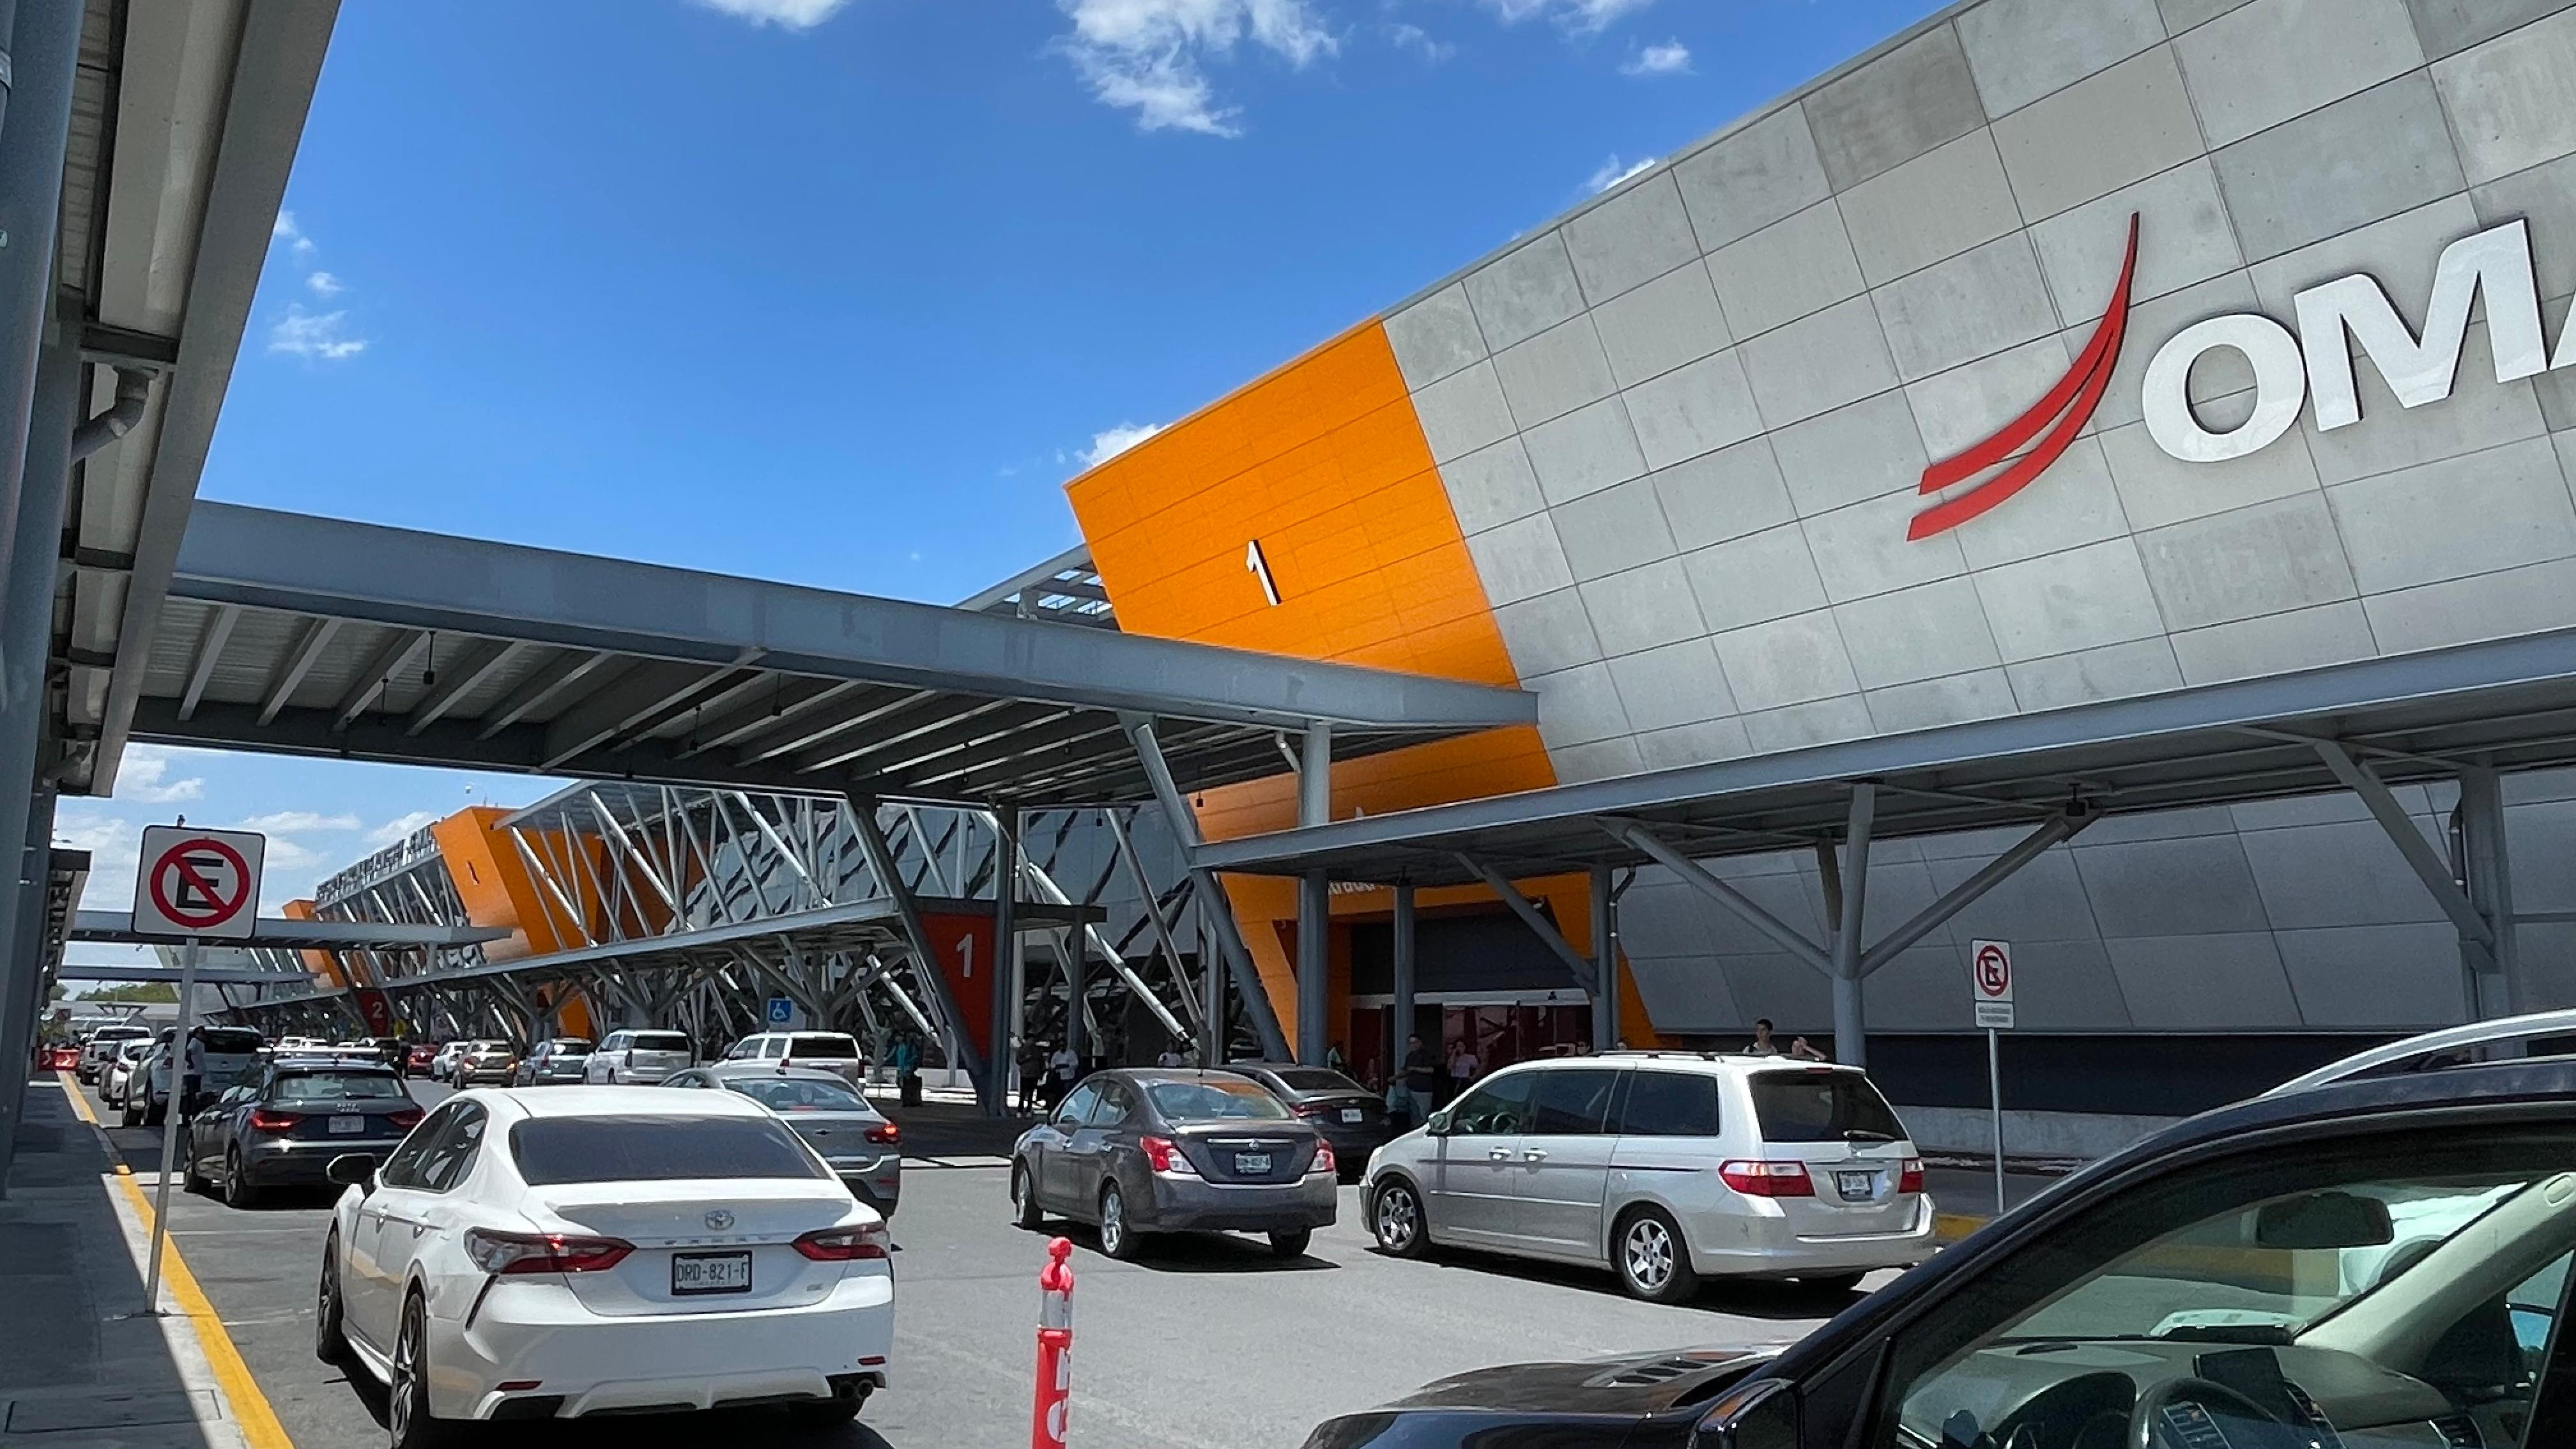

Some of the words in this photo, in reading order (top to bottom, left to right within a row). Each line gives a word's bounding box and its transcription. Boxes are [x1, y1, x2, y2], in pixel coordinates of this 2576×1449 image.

[2142, 218, 2576, 463] OM
[1246, 539, 1282, 606] 1
[956, 933, 972, 977] 1
[372, 1002, 383, 1018] 2
